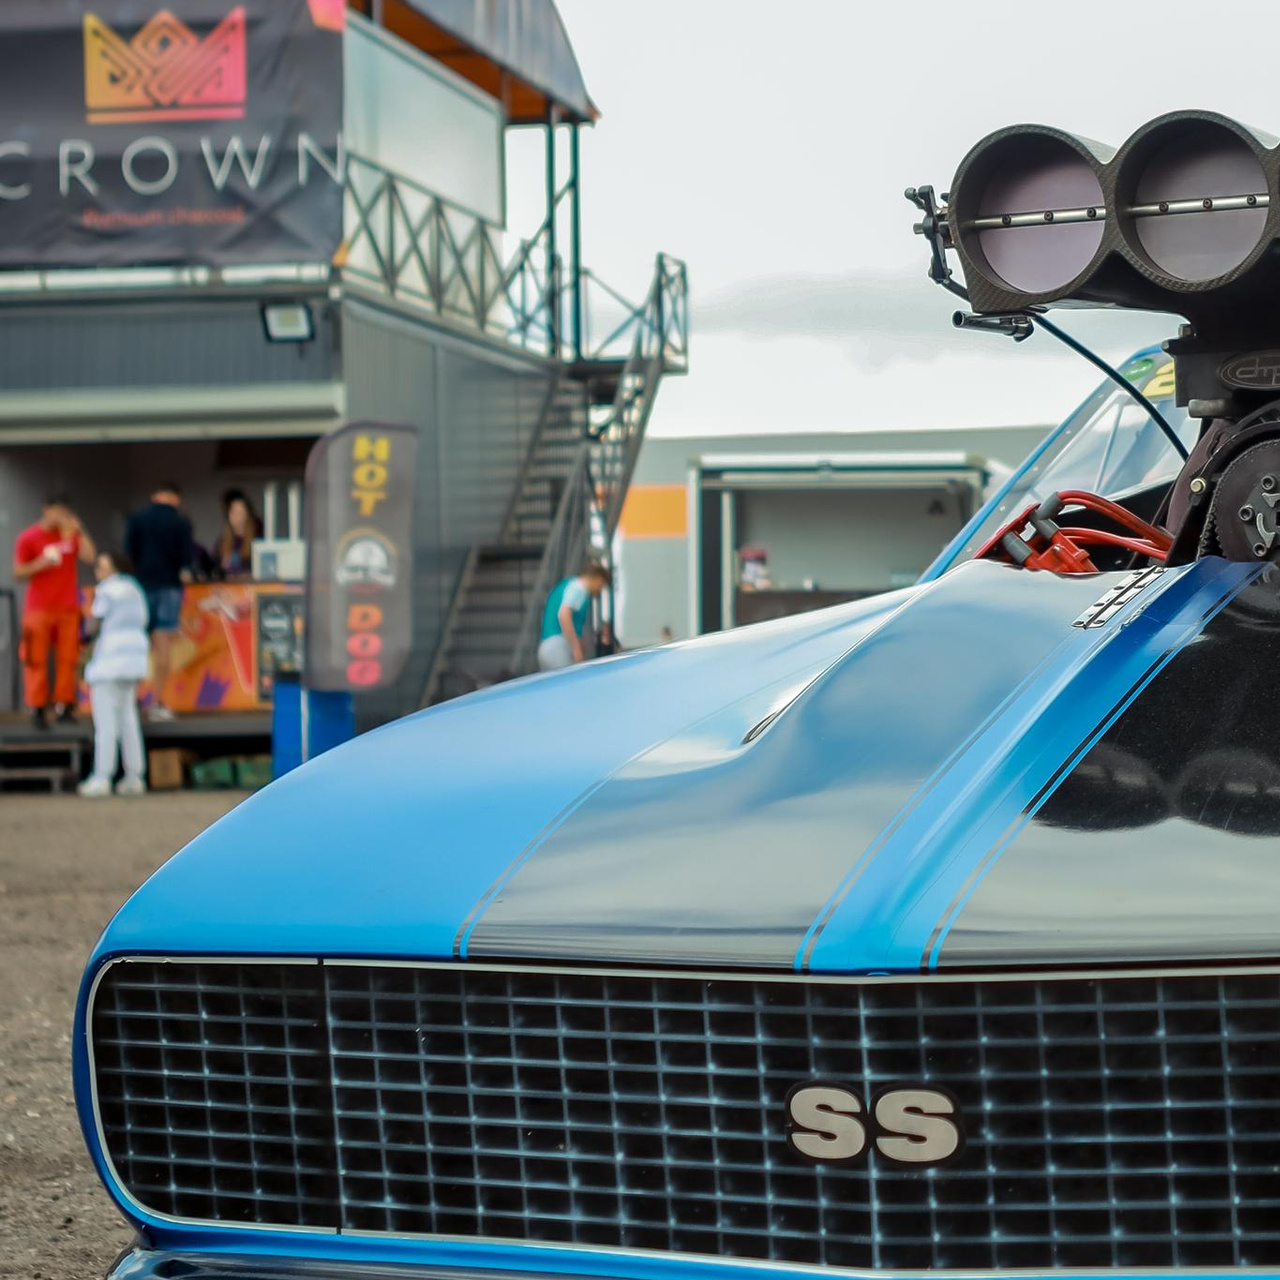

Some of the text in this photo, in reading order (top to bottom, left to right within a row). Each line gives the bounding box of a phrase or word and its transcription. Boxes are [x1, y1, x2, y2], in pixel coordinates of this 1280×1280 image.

[0, 131, 347, 201] CROWN
[352, 434, 391, 517] HOT
[346, 603, 383, 686] DOG
[790, 1086, 959, 1162] SS
